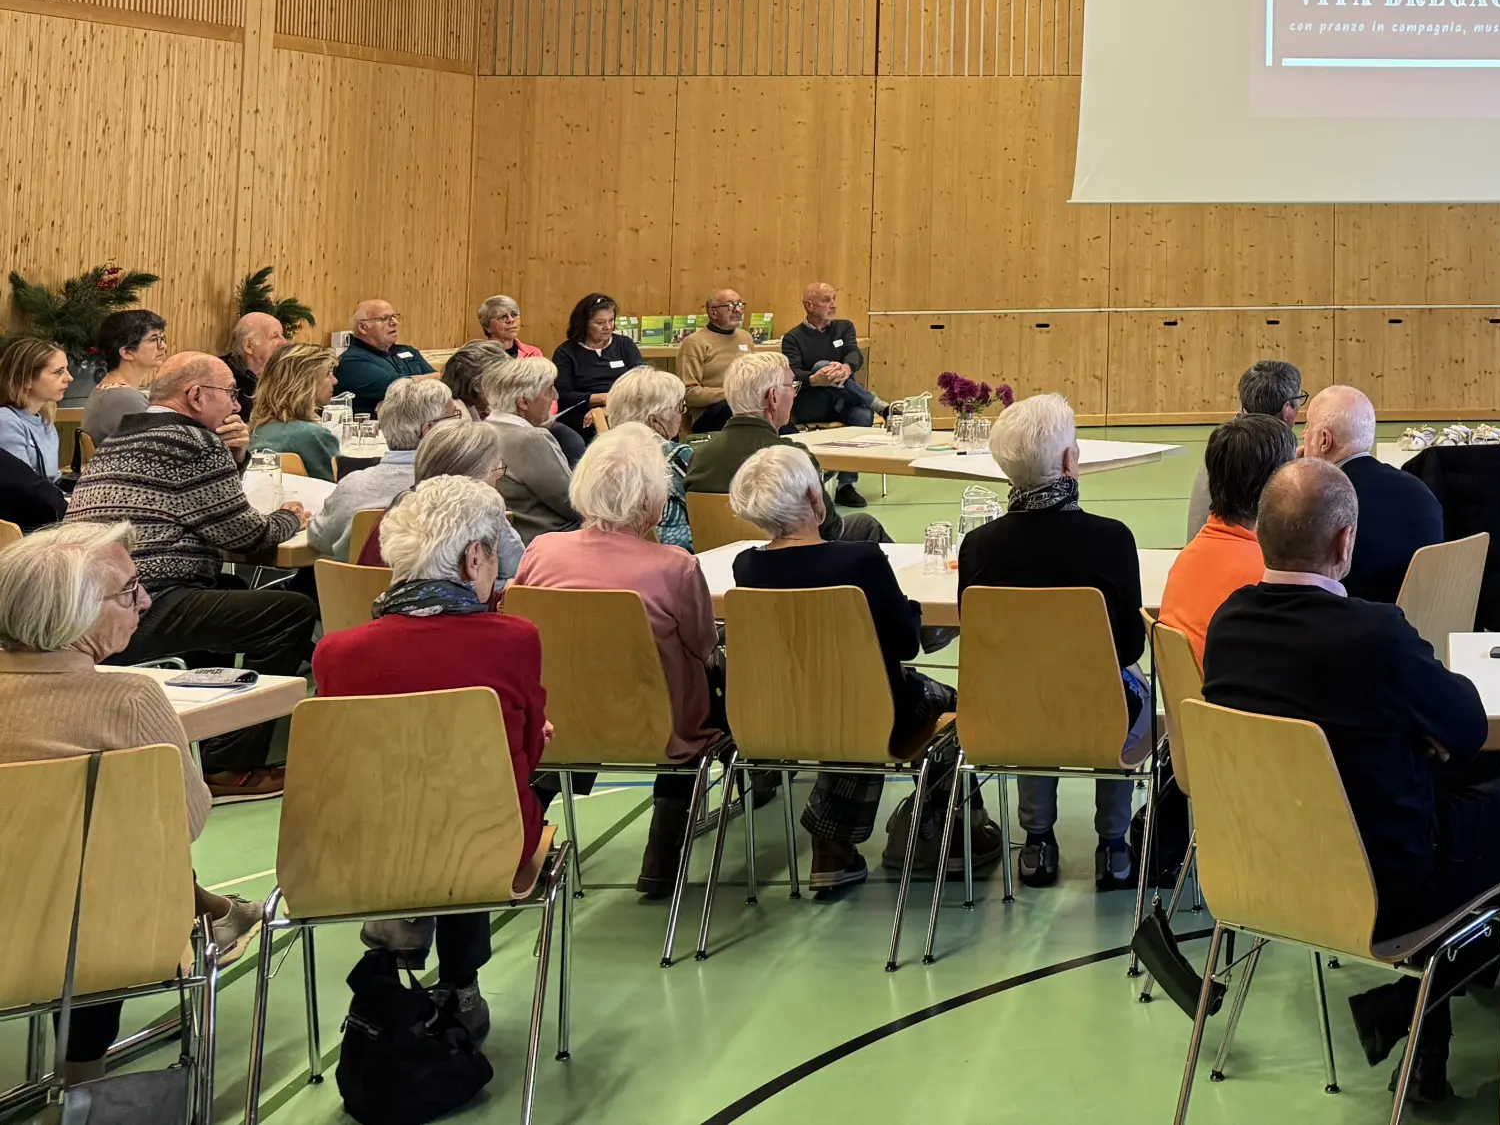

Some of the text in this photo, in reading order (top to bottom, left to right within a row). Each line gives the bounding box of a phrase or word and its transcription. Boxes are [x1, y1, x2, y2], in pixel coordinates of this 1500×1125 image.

[1289, 22, 1313, 32] con
[1319, 22, 1365, 34] pranzo
[1371, 20, 1385, 32] in
[1391, 20, 1467, 35] compagnia,
